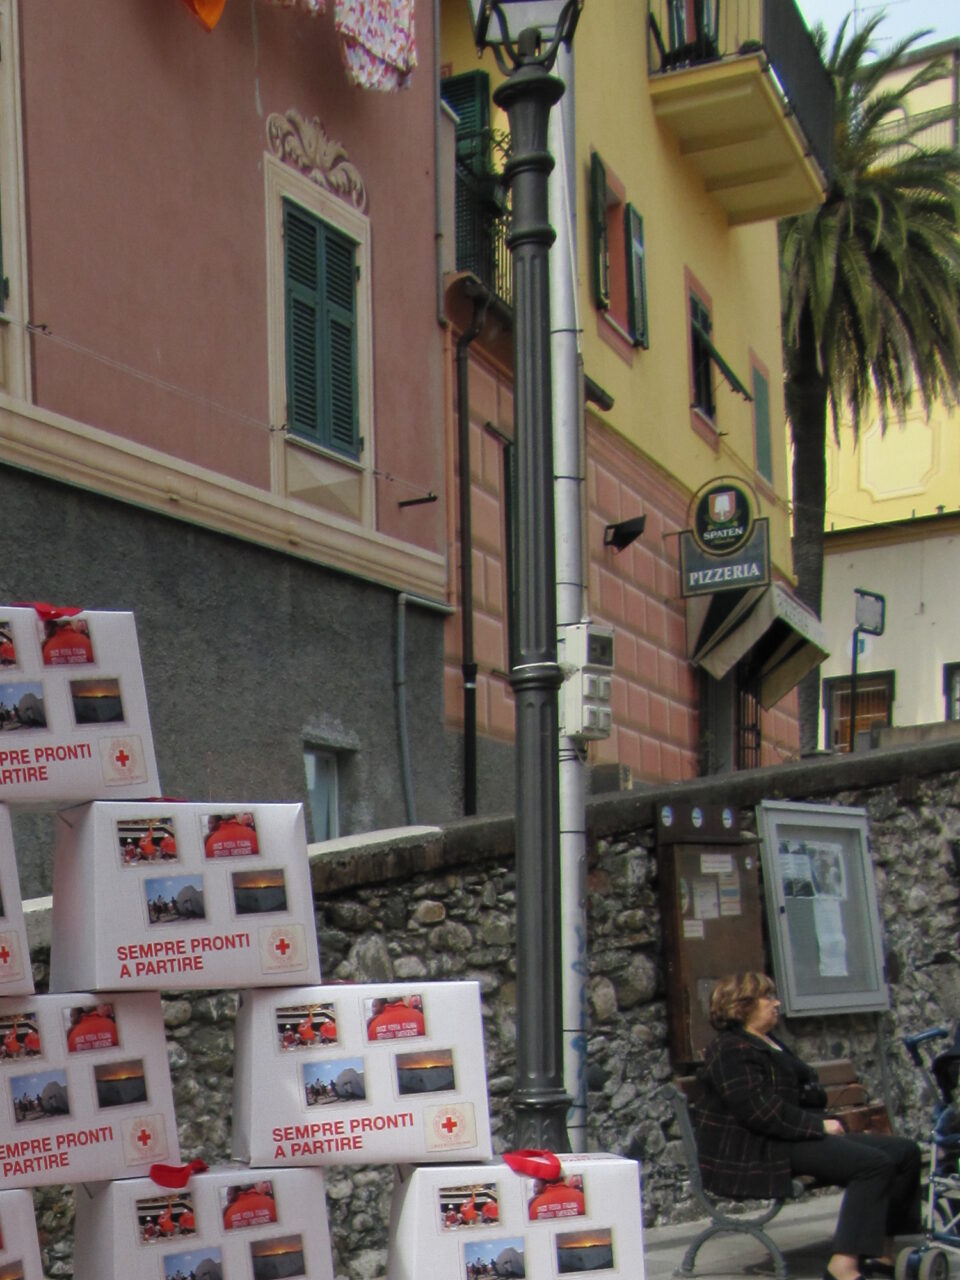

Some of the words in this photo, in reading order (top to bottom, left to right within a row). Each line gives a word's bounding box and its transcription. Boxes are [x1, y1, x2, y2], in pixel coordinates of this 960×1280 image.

[703, 527, 744, 541] SPATEN
[689, 562, 761, 586] PIZZERIA
[33, 742, 92, 767] PRONTI
[117, 939, 186, 963] SEMPRE
[190, 931, 251, 957] PRONTI
[119, 962, 132, 978] A
[135, 954, 203, 977] PARTIRE
[55, 1126, 113, 1150] PRONTI
[273, 1120, 344, 1143] SEMPRE
[349, 1112, 414, 1137] PRONTI
[275, 1143, 287, 1159] A
[290, 1134, 362, 1158] PARTIRE
[2, 1151, 69, 1178] PARTIRE
